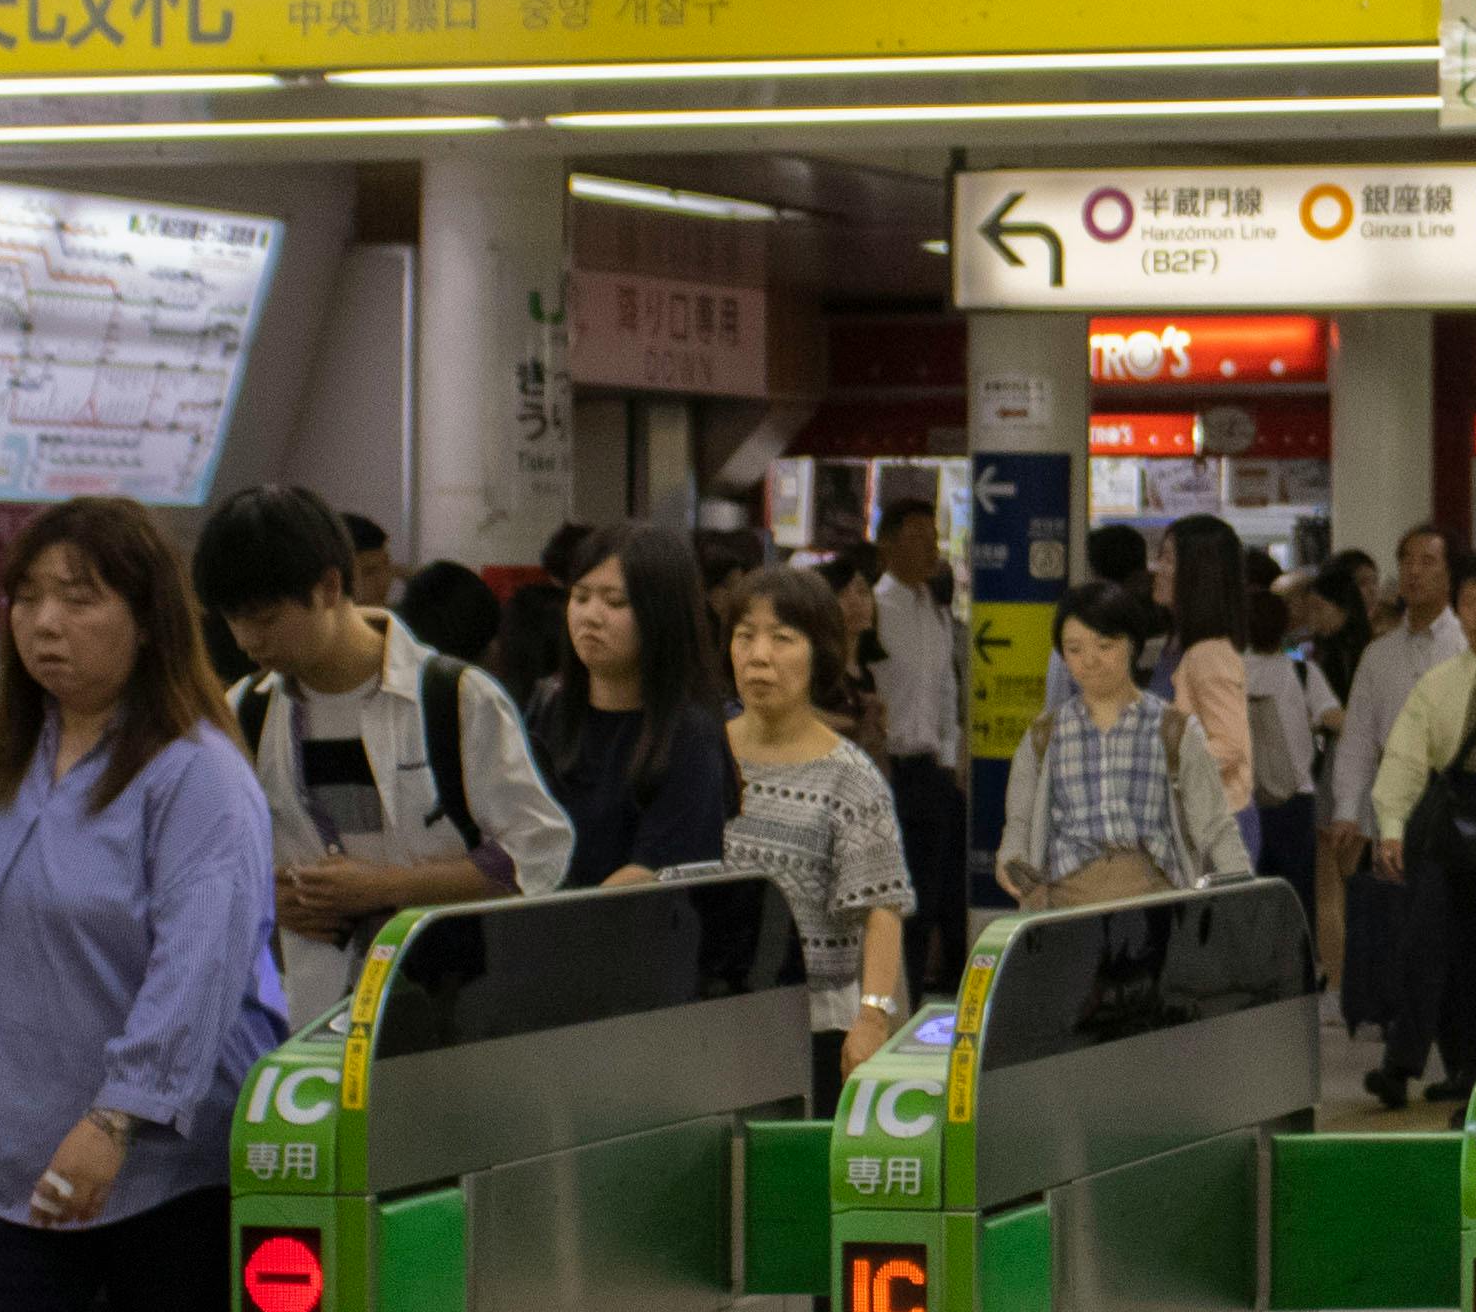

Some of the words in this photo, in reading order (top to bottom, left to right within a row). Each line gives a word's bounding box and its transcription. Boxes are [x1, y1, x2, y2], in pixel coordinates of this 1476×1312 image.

[1143, 187, 1263, 217] 半蔵門線
[1362, 185, 1453, 216] 銀座線
[1241, 226, 1278, 240] Line
[1361, 221, 1411, 240] Ginza
[1418, 219, 1455, 238] Line
[1141, 248, 1219, 275] (B2F)
[245, 1066, 340, 1125] IC
[846, 1078, 944, 1139] IC
[245, 1142, 317, 1179] 専用
[847, 1157, 923, 1195] 専用
